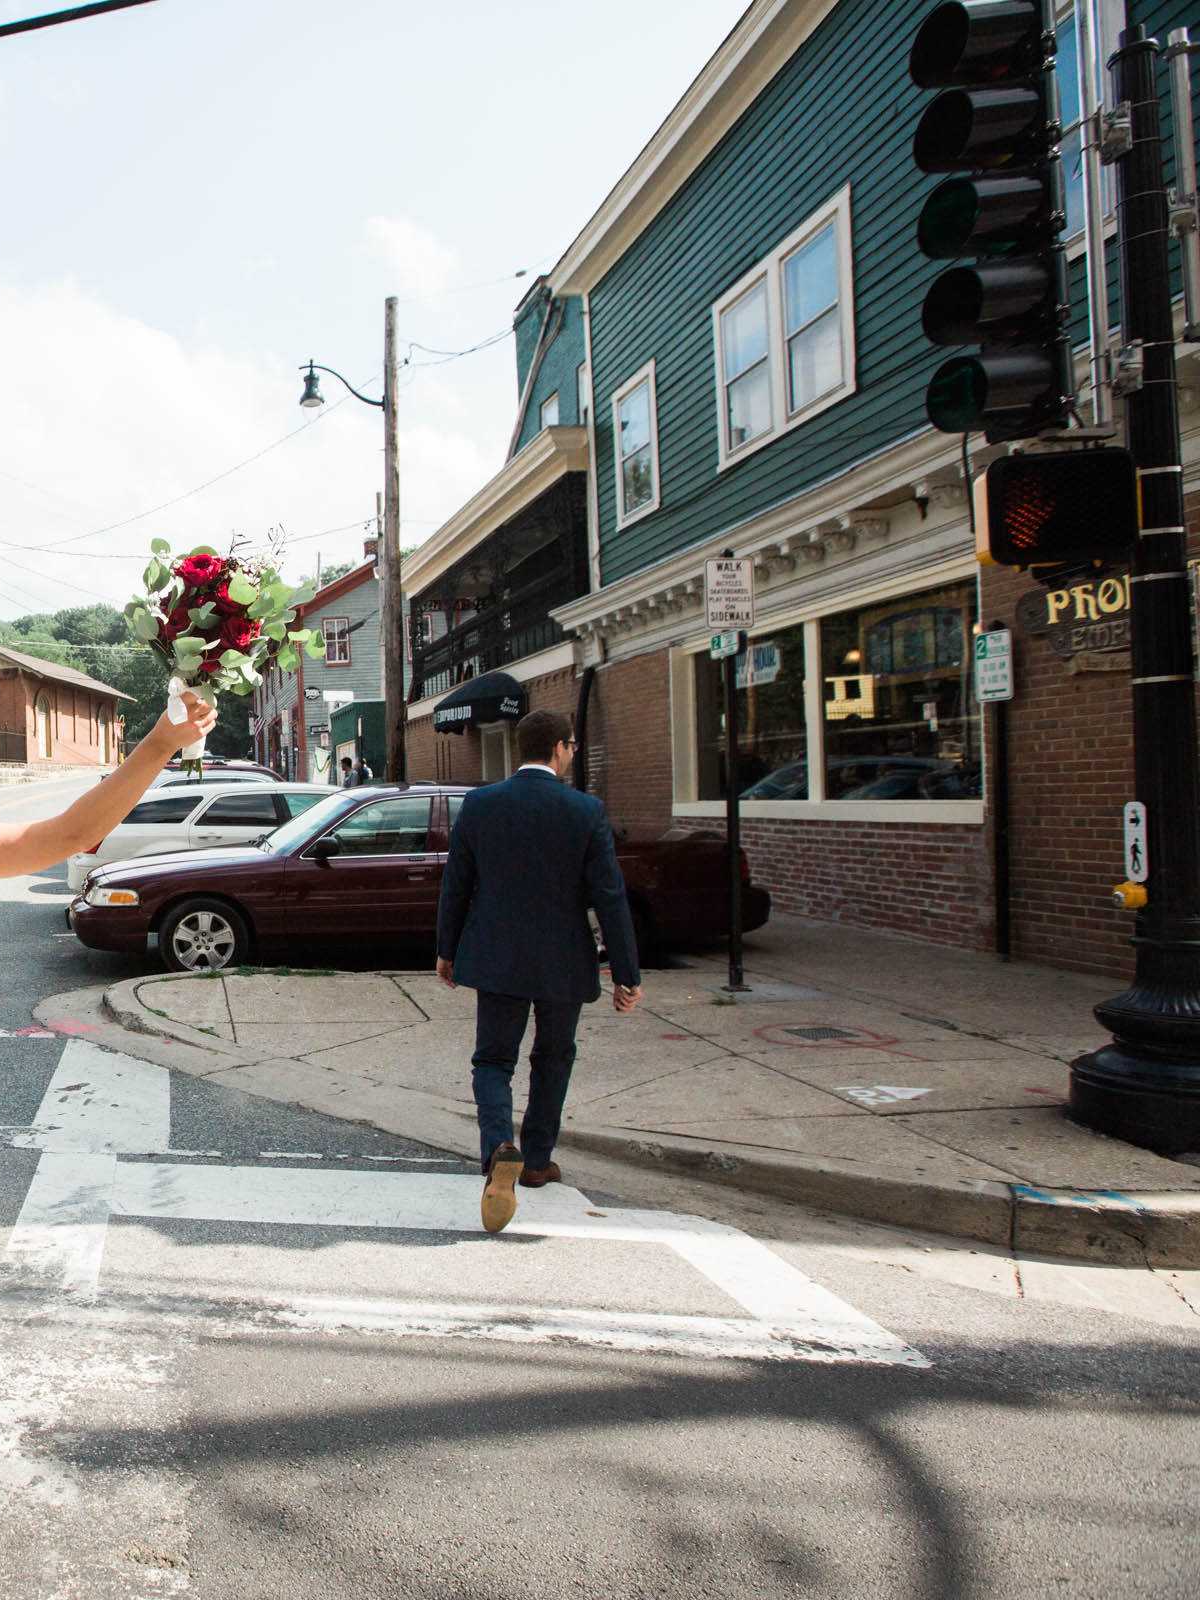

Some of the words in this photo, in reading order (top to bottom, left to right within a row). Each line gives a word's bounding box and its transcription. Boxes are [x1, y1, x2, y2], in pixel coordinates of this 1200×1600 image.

[716, 562, 742, 572] WALK
[710, 611, 751, 621] SIDEWALK
[976, 640, 985, 656] 2
[437, 705, 472, 722] EMPORIUM
